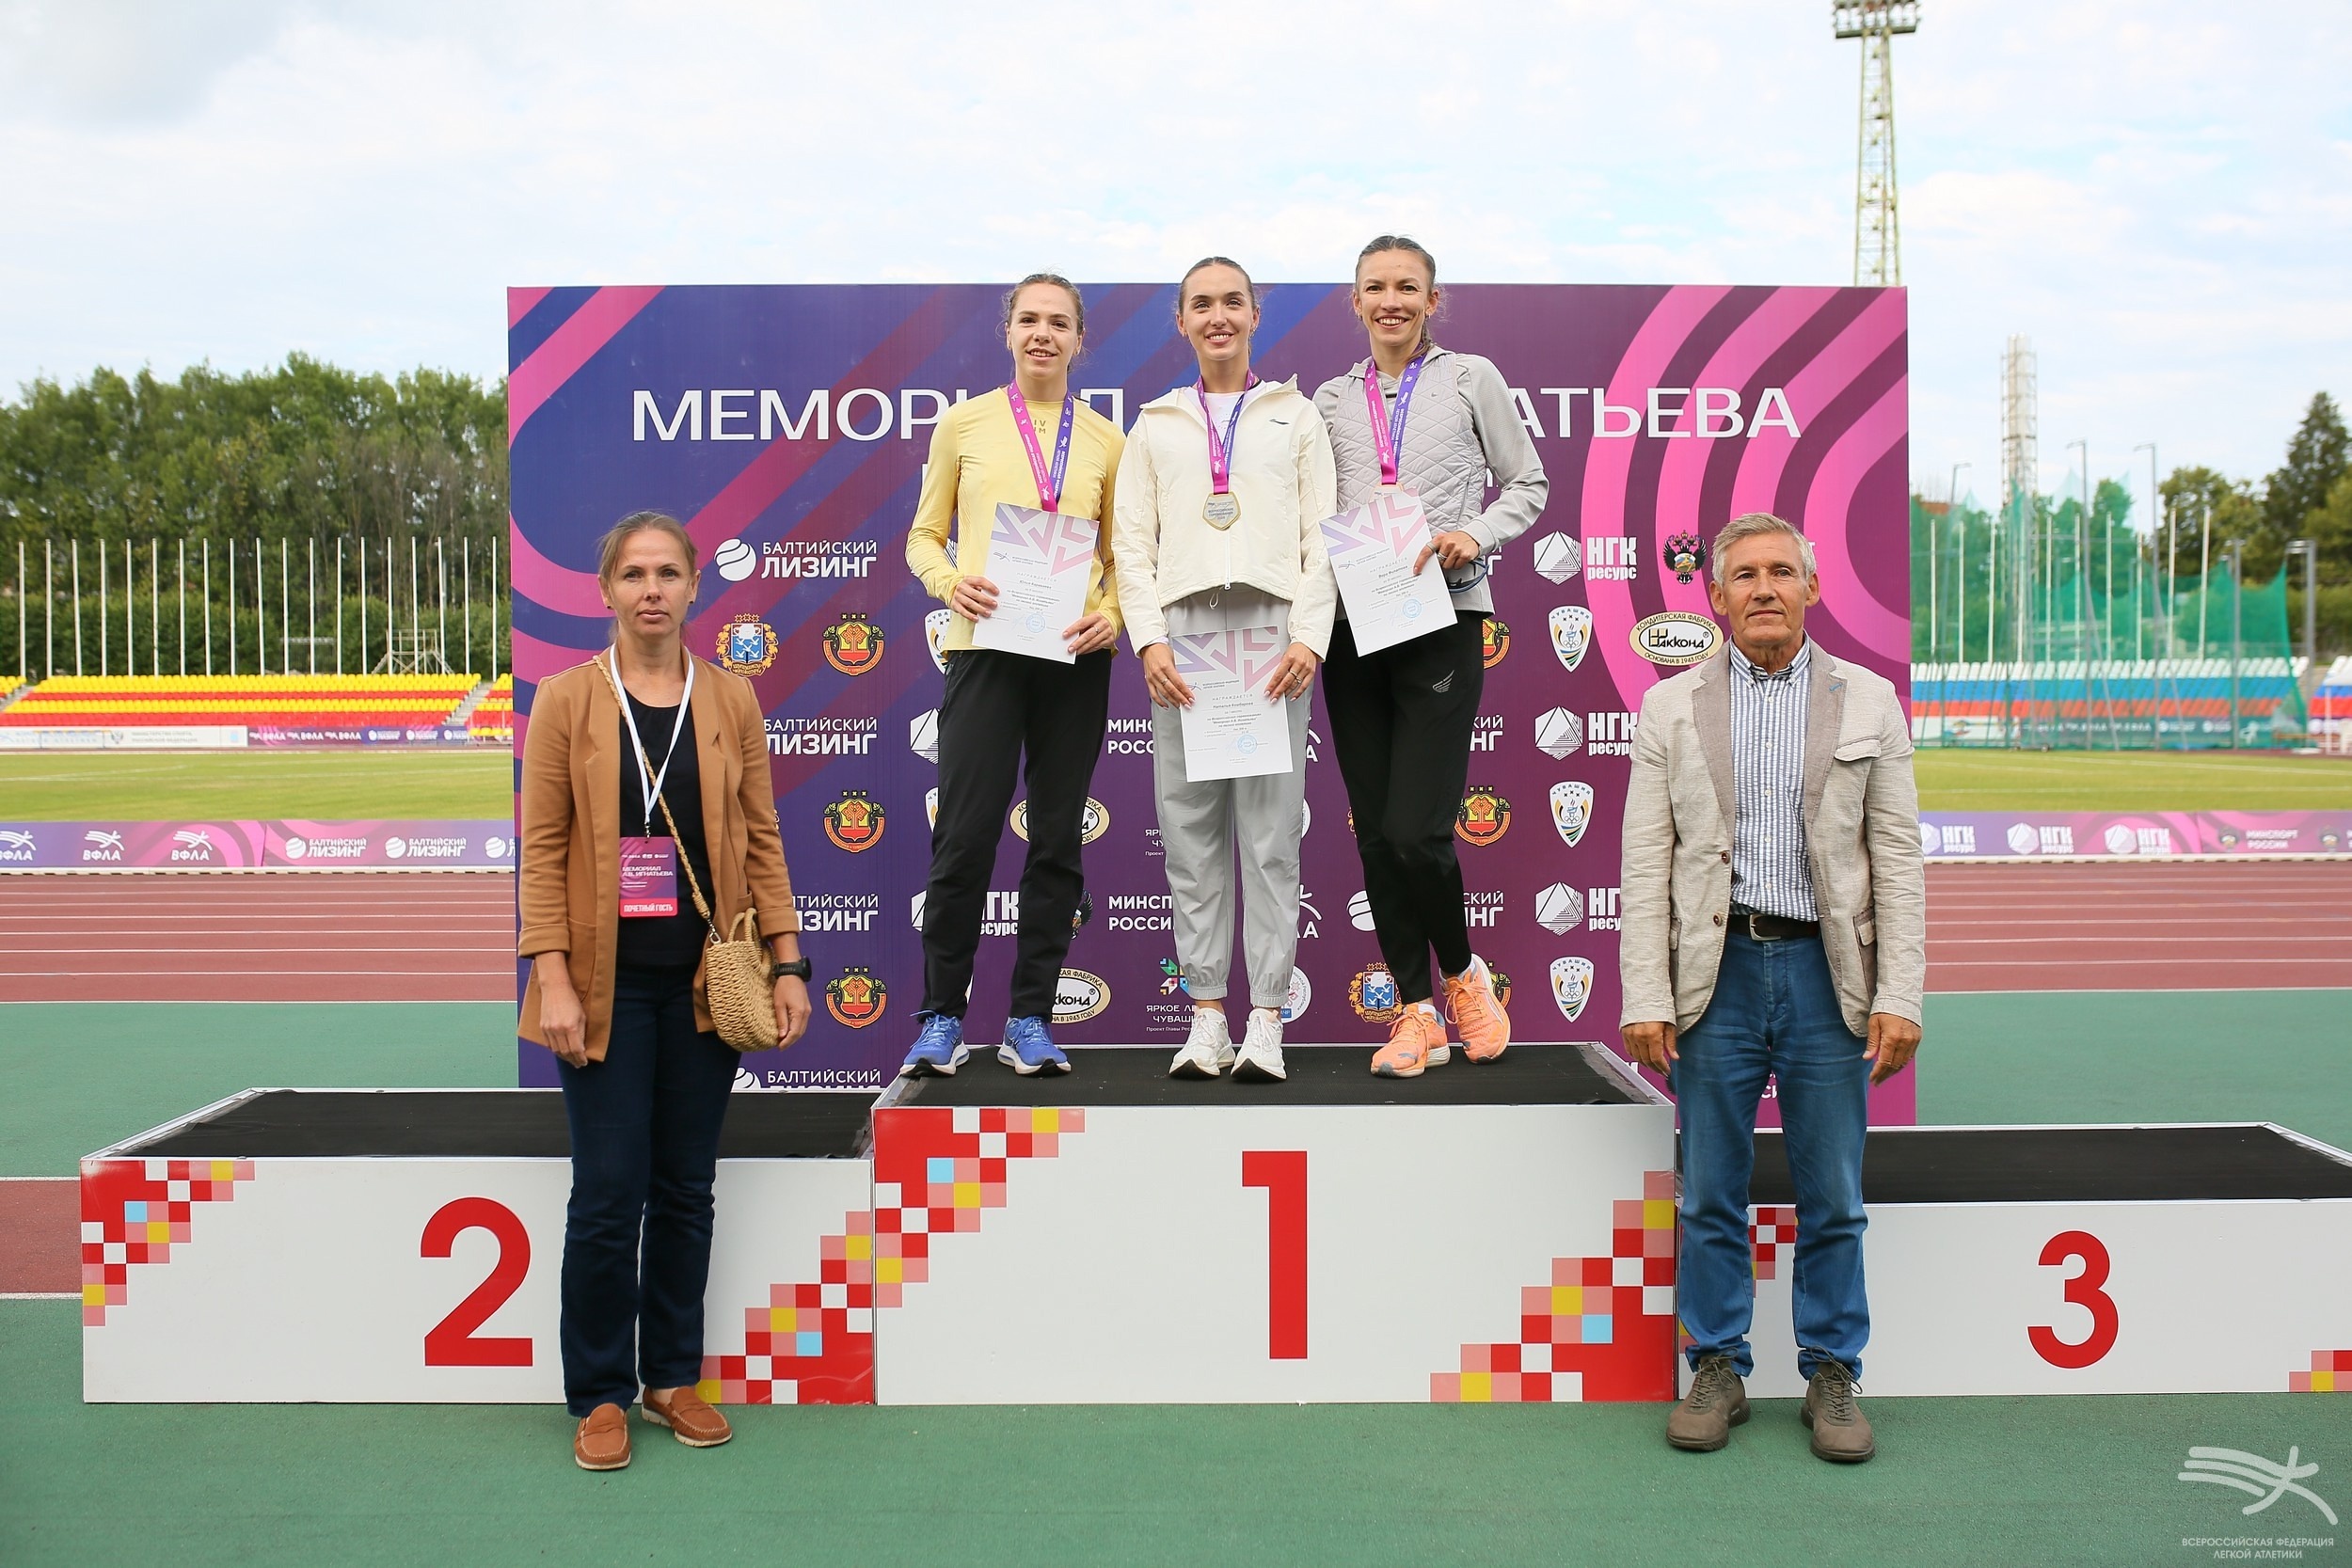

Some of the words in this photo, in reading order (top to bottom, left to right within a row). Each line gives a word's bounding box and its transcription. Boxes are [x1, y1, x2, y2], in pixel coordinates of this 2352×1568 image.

[1508, 388, 1801, 438] АТЬЕВА
[762, 540, 877, 555] БАЛТИЙСКИЙ
[1587, 537, 1637, 565] НГК
[761, 556, 877, 579] ЛИЗИНГ
[1587, 565, 1637, 581] ресурс
[764, 717, 877, 732] БАЛТИЙСКИЙ
[1588, 712, 1638, 741] НГК
[767, 734, 877, 754] ЛИЗИНГ
[1588, 742, 1633, 756] ресур
[1942, 825, 1975, 844] НГК
[83, 849, 121, 862] ВФЛА
[171, 849, 210, 862] ВФЛА
[307, 846, 366, 857] ЛИЗИНГ
[406, 846, 466, 857] ЛИЗИНГ
[792, 894, 878, 908] ТИЙСКИЙ
[982, 892, 1019, 921] ГК
[1108, 895, 1172, 910] МИНСП
[1588, 888, 1621, 916] НГ
[796, 911, 878, 931] ЗИНГ
[1108, 916, 1172, 931] РОССИ
[1588, 918, 1621, 931] ресу
[767, 1068, 881, 1083] БАЛТИЙСКИЙ
[1242, 1150, 1308, 1359] 1
[421, 1197, 533, 1366] 2
[2028, 1230, 2118, 1368] 3
